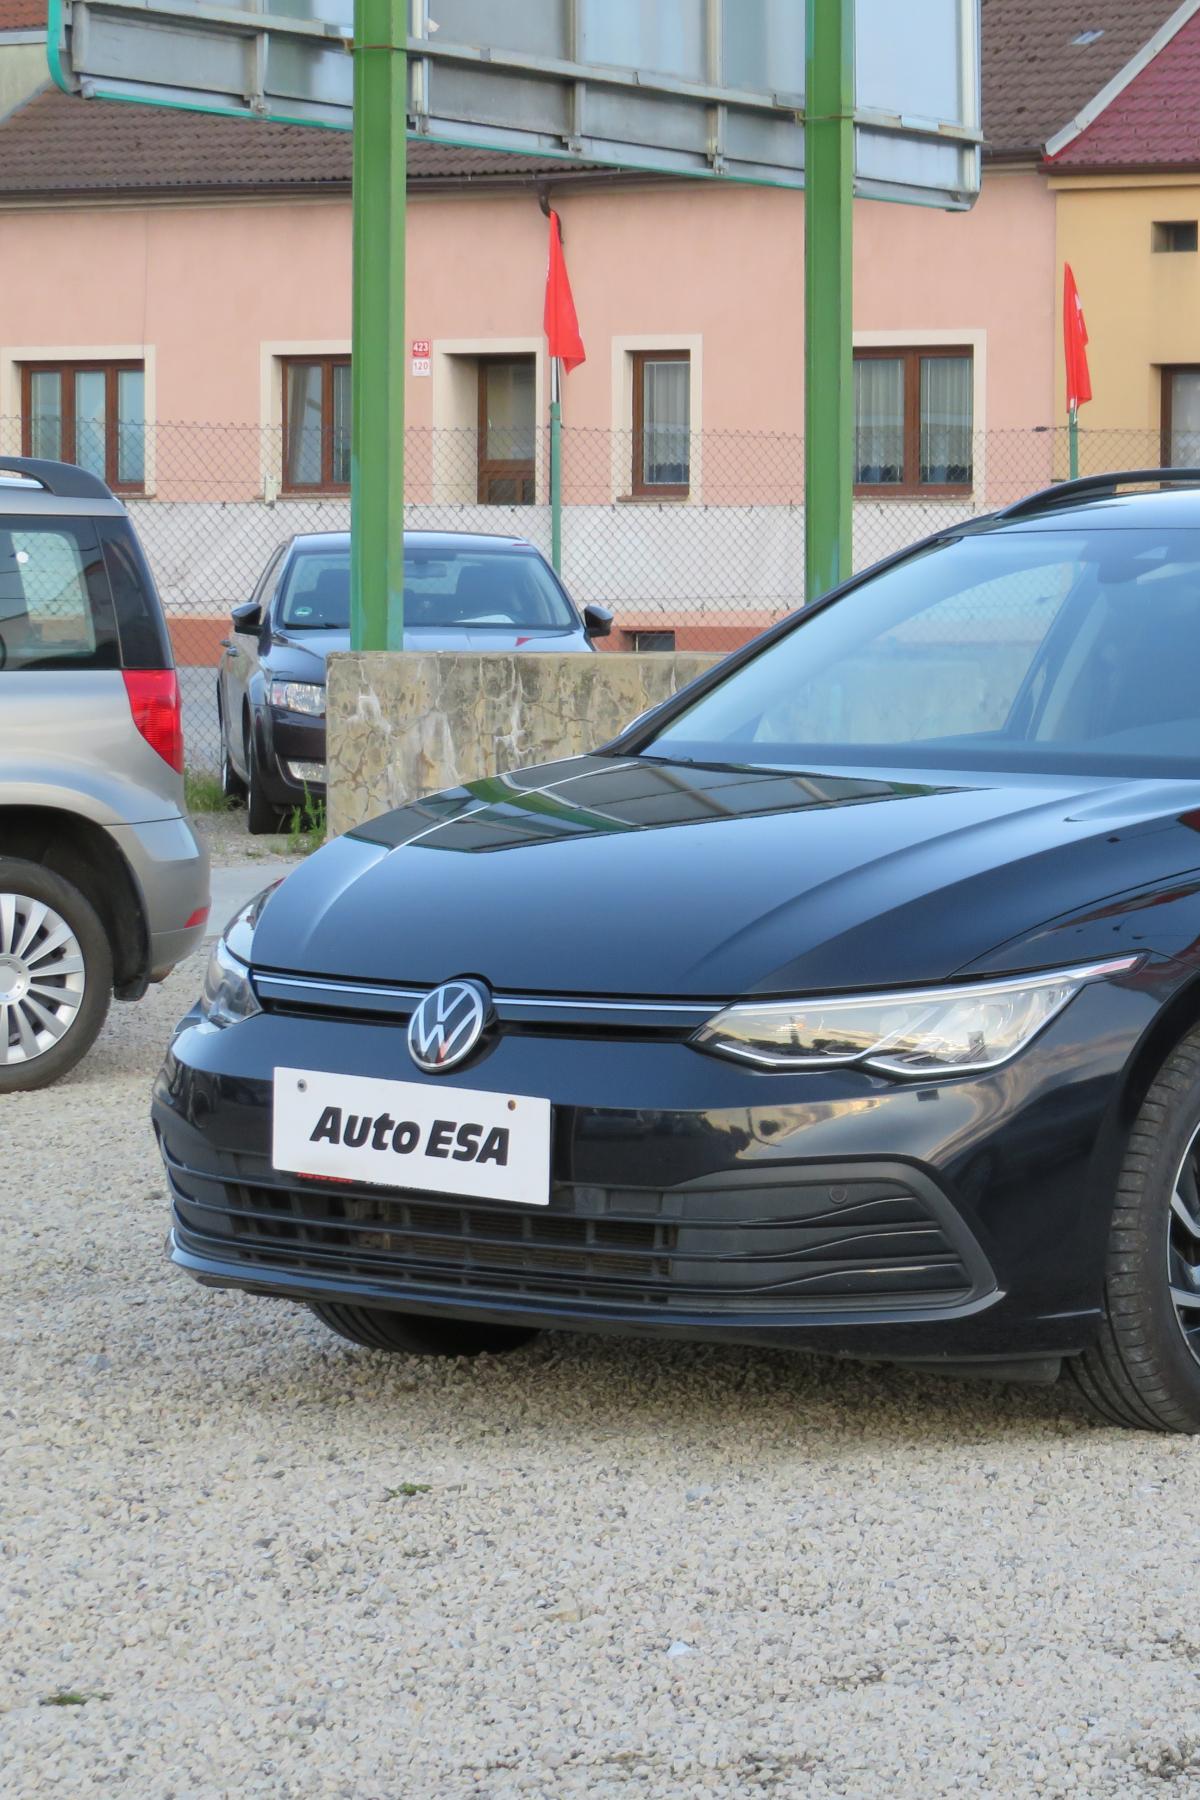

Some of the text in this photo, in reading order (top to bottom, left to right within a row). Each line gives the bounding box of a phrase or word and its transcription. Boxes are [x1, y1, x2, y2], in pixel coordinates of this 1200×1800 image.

[413, 342, 429, 352] 423
[413, 361, 429, 370] 120
[309, 1105, 510, 1167] Auto ESA
